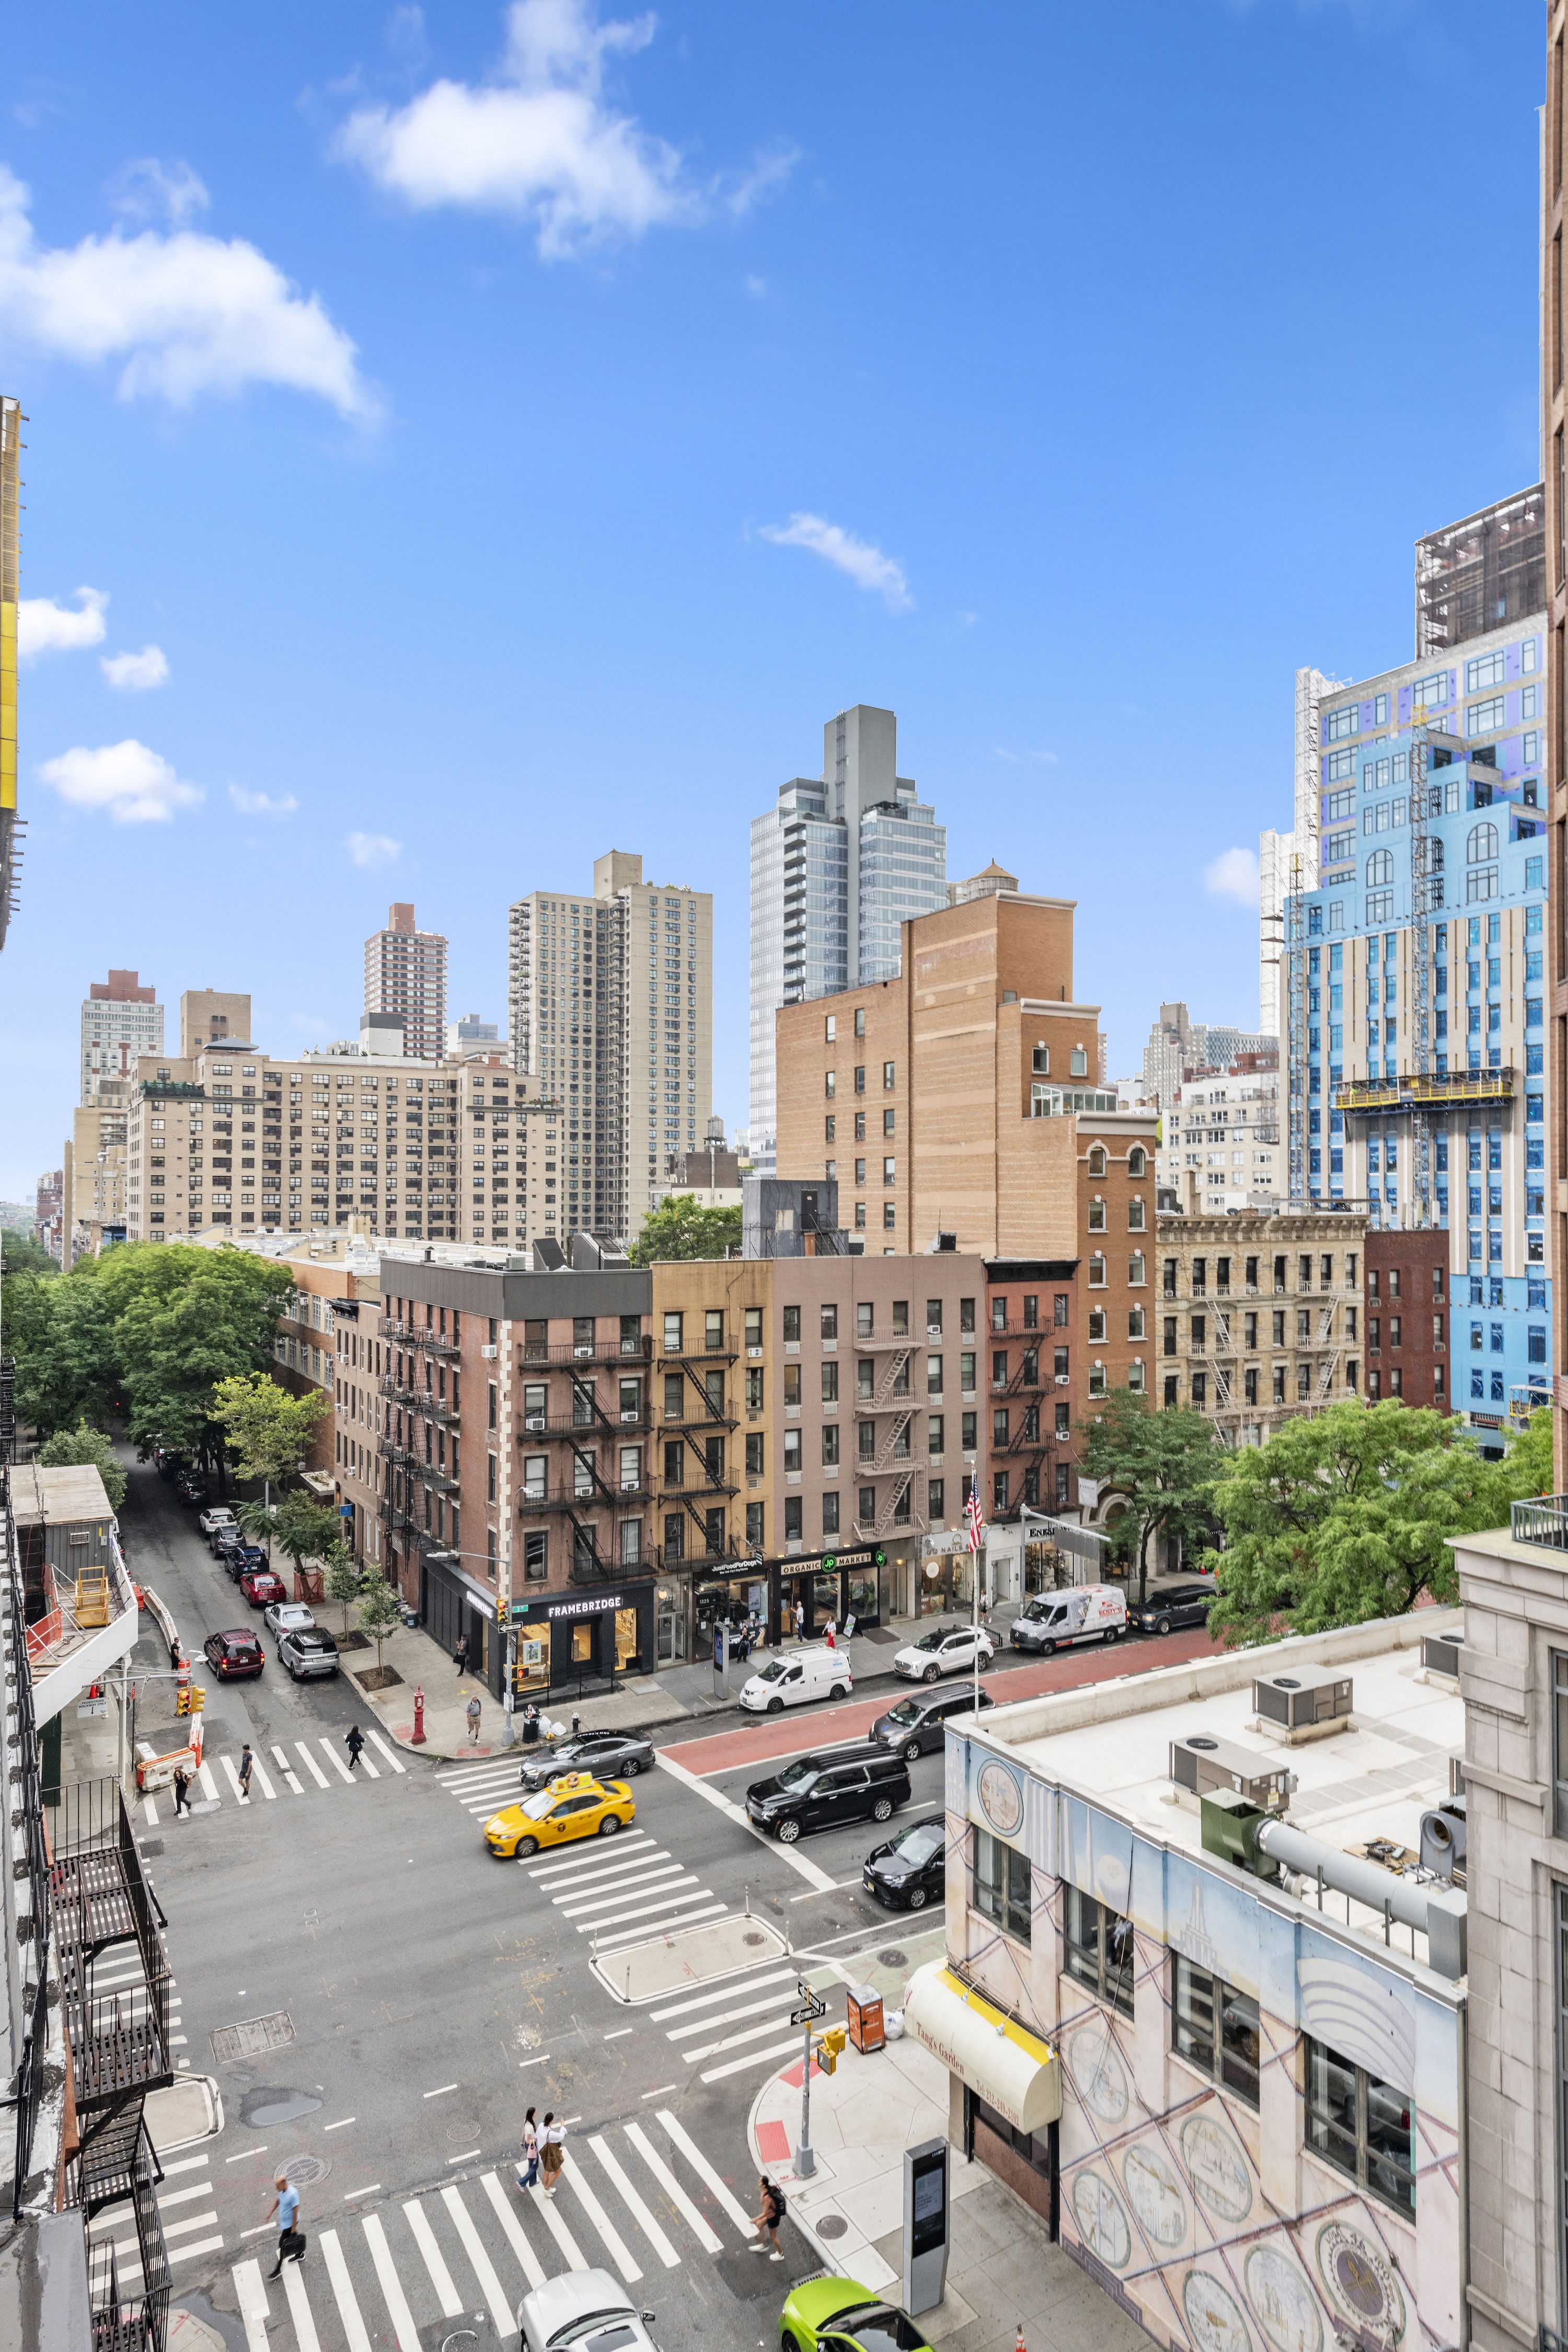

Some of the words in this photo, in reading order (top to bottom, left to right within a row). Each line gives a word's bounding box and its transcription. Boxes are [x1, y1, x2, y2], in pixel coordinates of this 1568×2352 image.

[941, 1544, 963, 1553] NAILS
[711, 1560, 757, 1572] JustFoodForDogs
[783, 1562, 820, 1573] ORGANIC
[839, 1554, 871, 1565] MARKET
[549, 1597, 621, 1618] FRAMEBRIDGE
[1099, 1606, 1122, 1616] EDDY'S
[796, 2012, 805, 2021] ONE
[916, 2021, 937, 2051] Tang's
[939, 2043, 964, 2075] Garden
[976, 2079, 985, 2096] Tel:
[986, 2092, 1019, 2126] 212-249-2102
